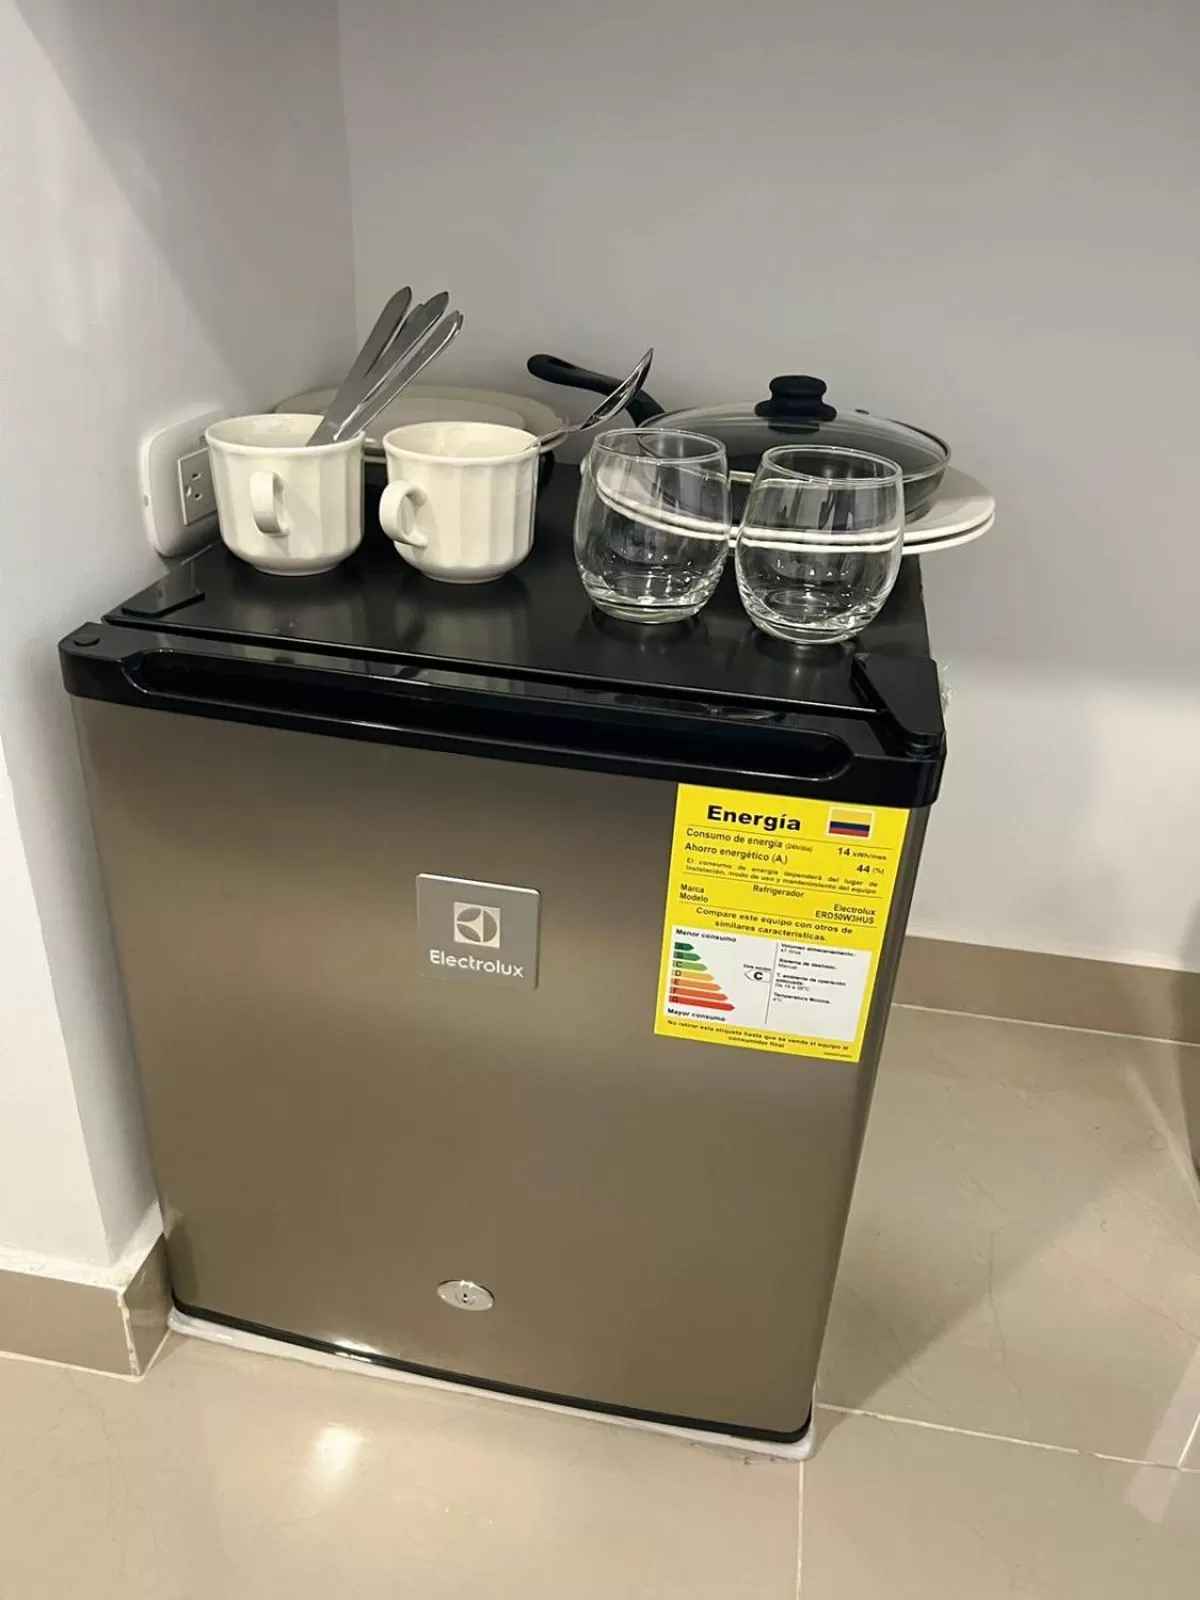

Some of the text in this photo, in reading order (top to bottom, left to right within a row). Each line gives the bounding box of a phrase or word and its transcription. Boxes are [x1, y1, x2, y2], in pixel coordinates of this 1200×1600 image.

[708, 804, 801, 831] Energía
[686, 828, 731, 840] Consumo
[734, 834, 745, 843] de
[748, 838, 782, 849] energía
[685, 842, 718, 854] Ahorro
[720, 848, 769, 860] energético
[838, 848, 850, 856] 14
[698, 860, 732, 868] consumo
[784, 872, 822, 880] dependerá
[856, 864, 870, 872] 44
[680, 884, 705, 894] Marca
[782, 879, 836, 889] mantenimiento
[752, 884, 804, 898] Refrigerador
[680, 892, 708, 903] Modelo
[834, 904, 876, 916] Electrolux
[696, 907, 737, 919] Compare
[760, 917, 792, 926] equipo
[814, 924, 838, 932] otros
[714, 921, 756, 932] similares
[676, 928, 737, 942] Menor consumo
[429, 949, 524, 978] Electrolux
[754, 972, 764, 980] C
[667, 1008, 726, 1022] Mayor consumo
[716, 1028, 742, 1036] etiqueta
[728, 1035, 768, 1046] consumidor
